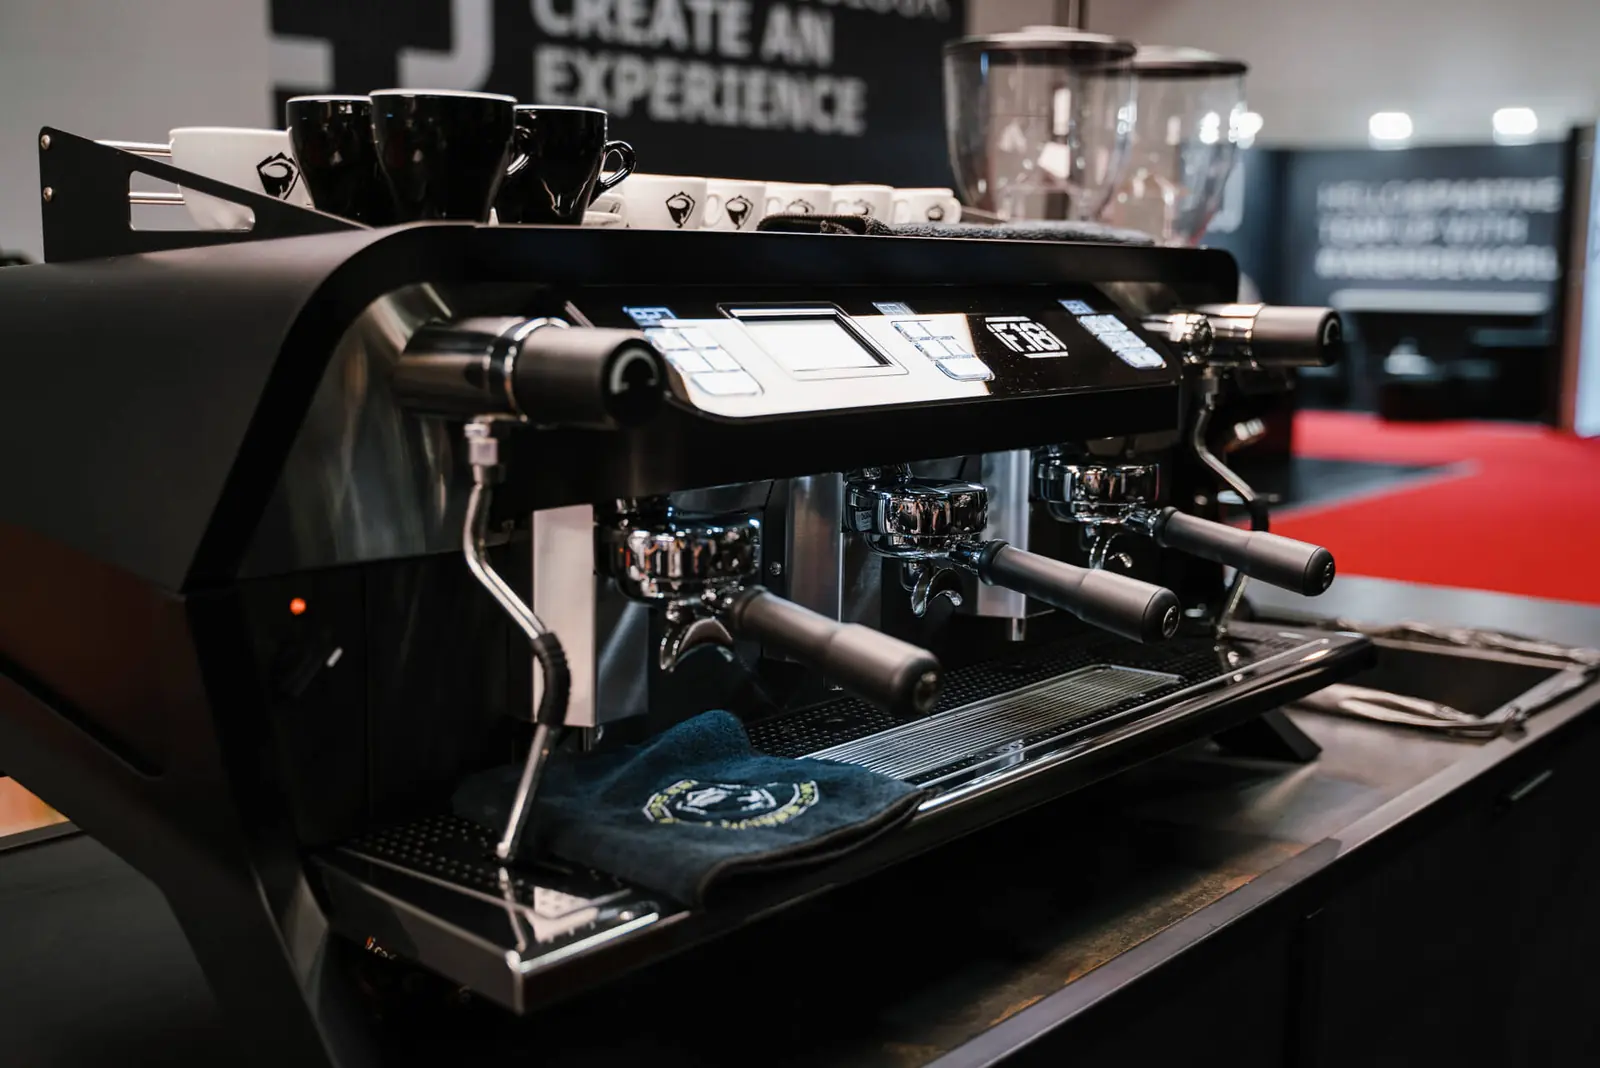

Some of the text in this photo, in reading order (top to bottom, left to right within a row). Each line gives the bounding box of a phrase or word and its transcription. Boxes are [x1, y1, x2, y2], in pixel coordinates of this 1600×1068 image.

[531, 0, 834, 67] CREATE AN
[534, 44, 867, 135] EXPERIENCE
